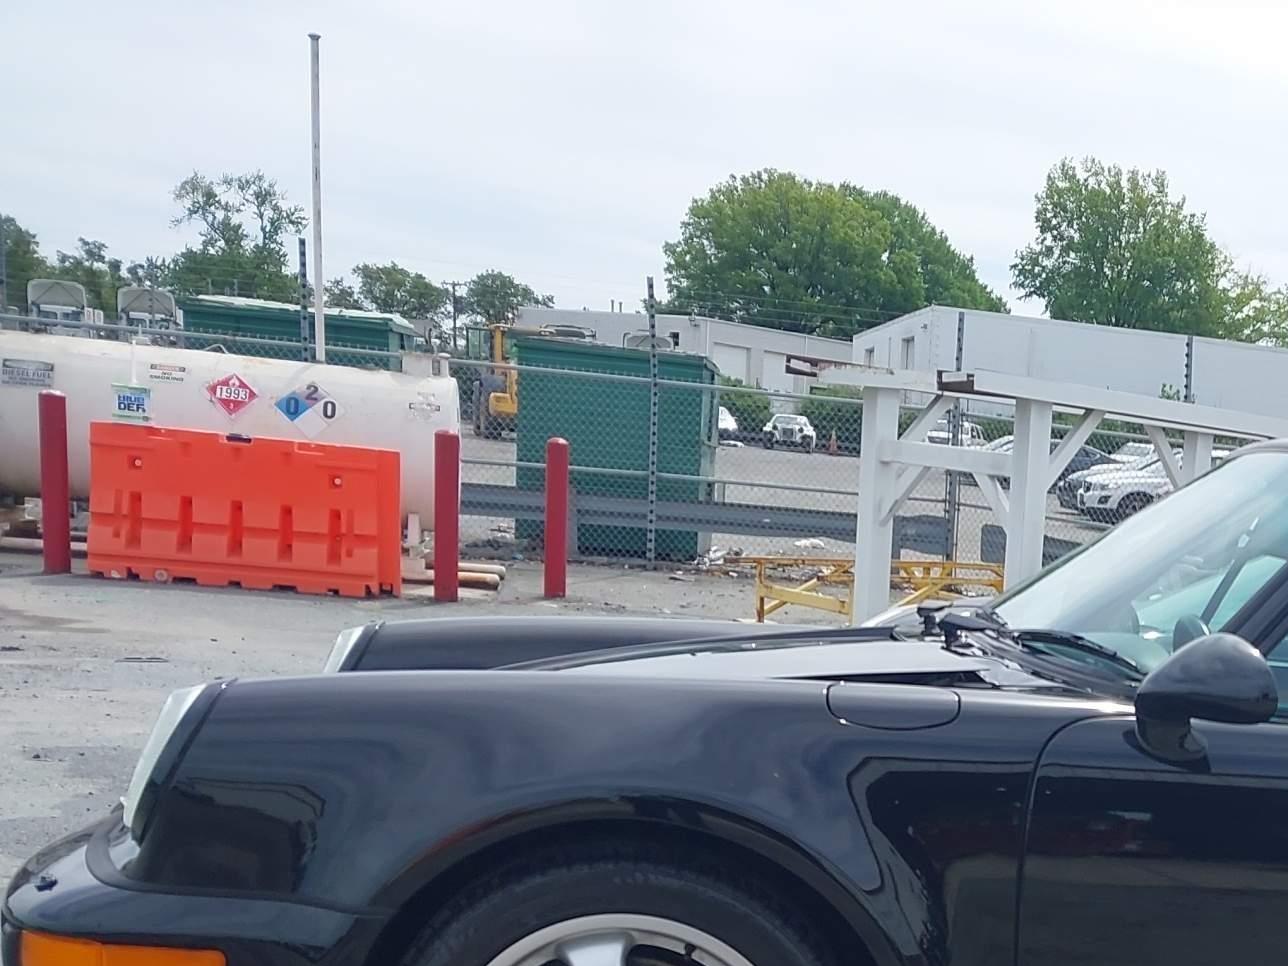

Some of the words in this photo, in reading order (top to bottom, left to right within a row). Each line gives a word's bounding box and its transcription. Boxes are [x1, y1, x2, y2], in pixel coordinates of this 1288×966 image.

[219, 386, 249, 401] 1993
[305, 384, 319, 401] 2
[285, 396, 300, 416] 0
[322, 400, 337, 420] 0
